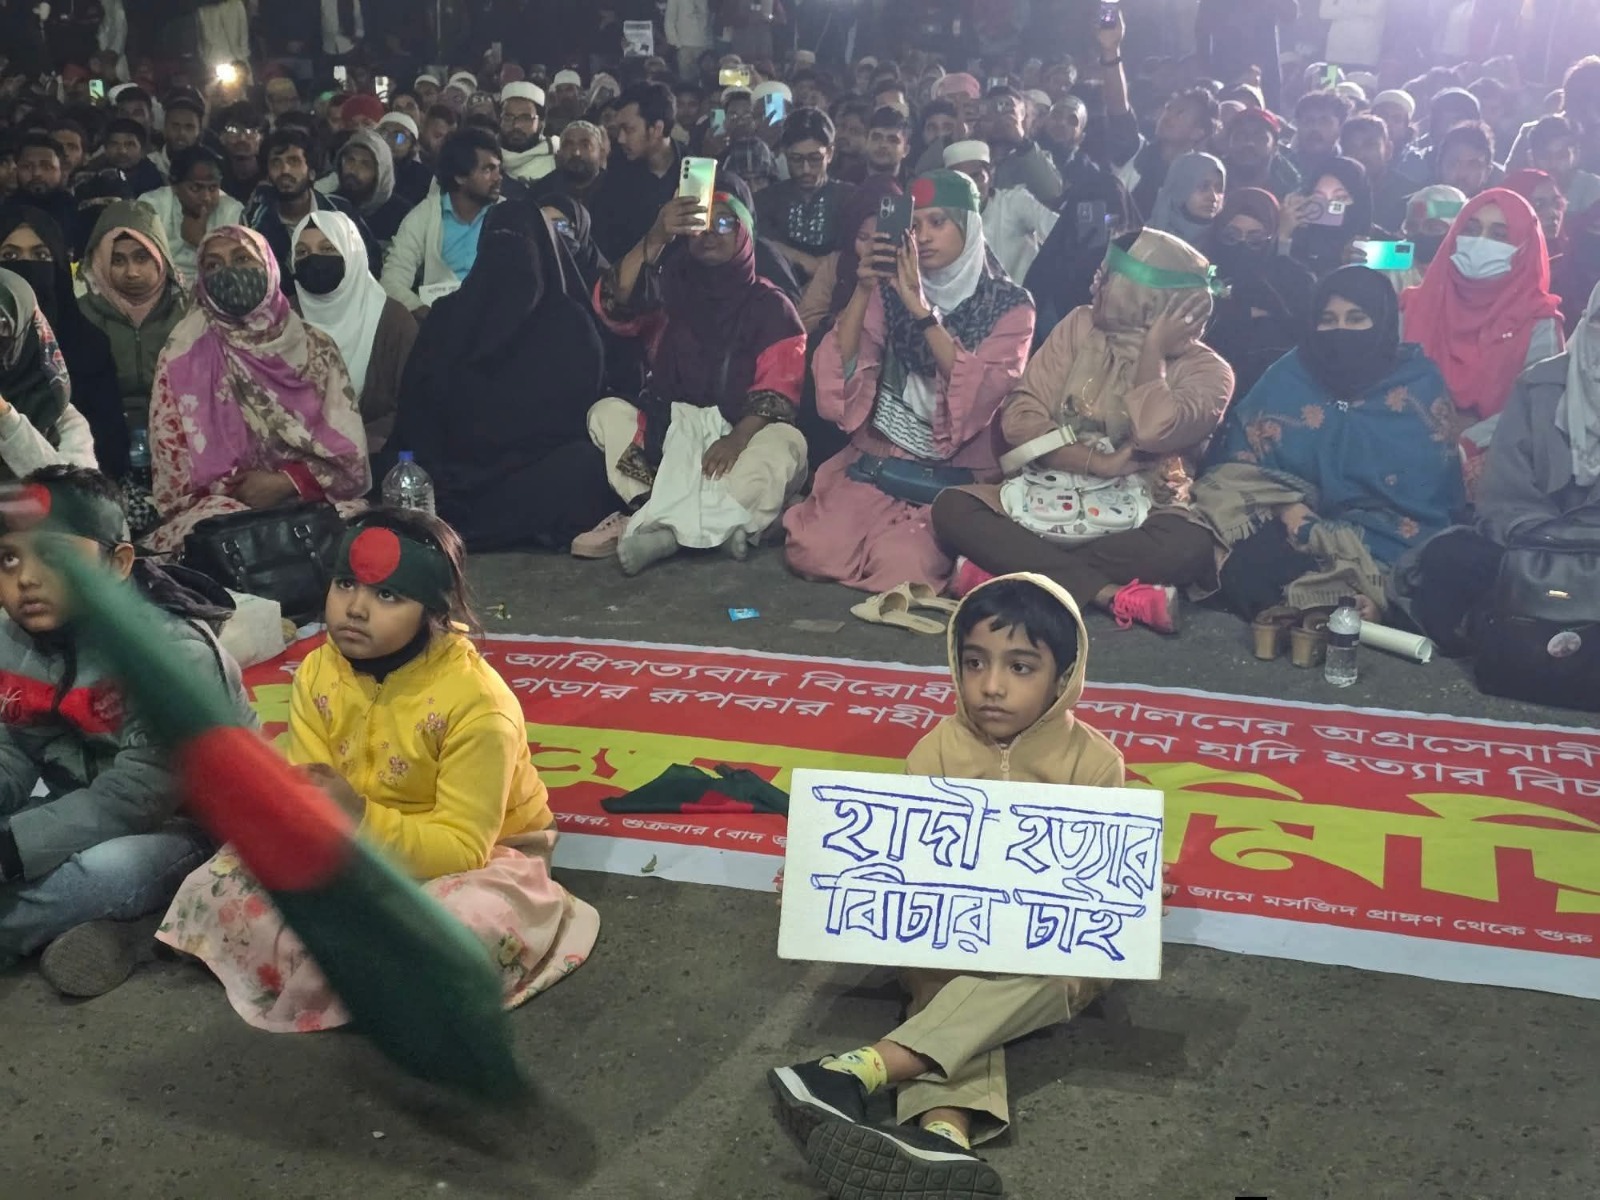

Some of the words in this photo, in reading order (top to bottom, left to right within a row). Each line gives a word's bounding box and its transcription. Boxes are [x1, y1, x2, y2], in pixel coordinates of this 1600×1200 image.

[505, 651, 788, 687] আধিপত্যবাদ
[512, 677, 639, 701] গড়ার
[649, 688, 834, 717] রূপকার
[847, 704, 957, 729] শহী
[1195, 739, 1305, 764] হাদি
[1323, 750, 1490, 786] হত্যার
[622, 818, 709, 835] শুক্রবার
[1187, 885, 1255, 902] জামে
[1263, 895, 1357, 916] মসজিদ
[1366, 908, 1444, 927] প্রাঙ্গণ
[1453, 919, 1525, 936] থেকে
[1534, 928, 1593, 944] শুরু
[812, 776, 1000, 869] হাদী
[1006, 804, 1162, 898] হত্যার
[811, 862, 1009, 953] বিচার
[1013, 877, 1146, 960] চাই
